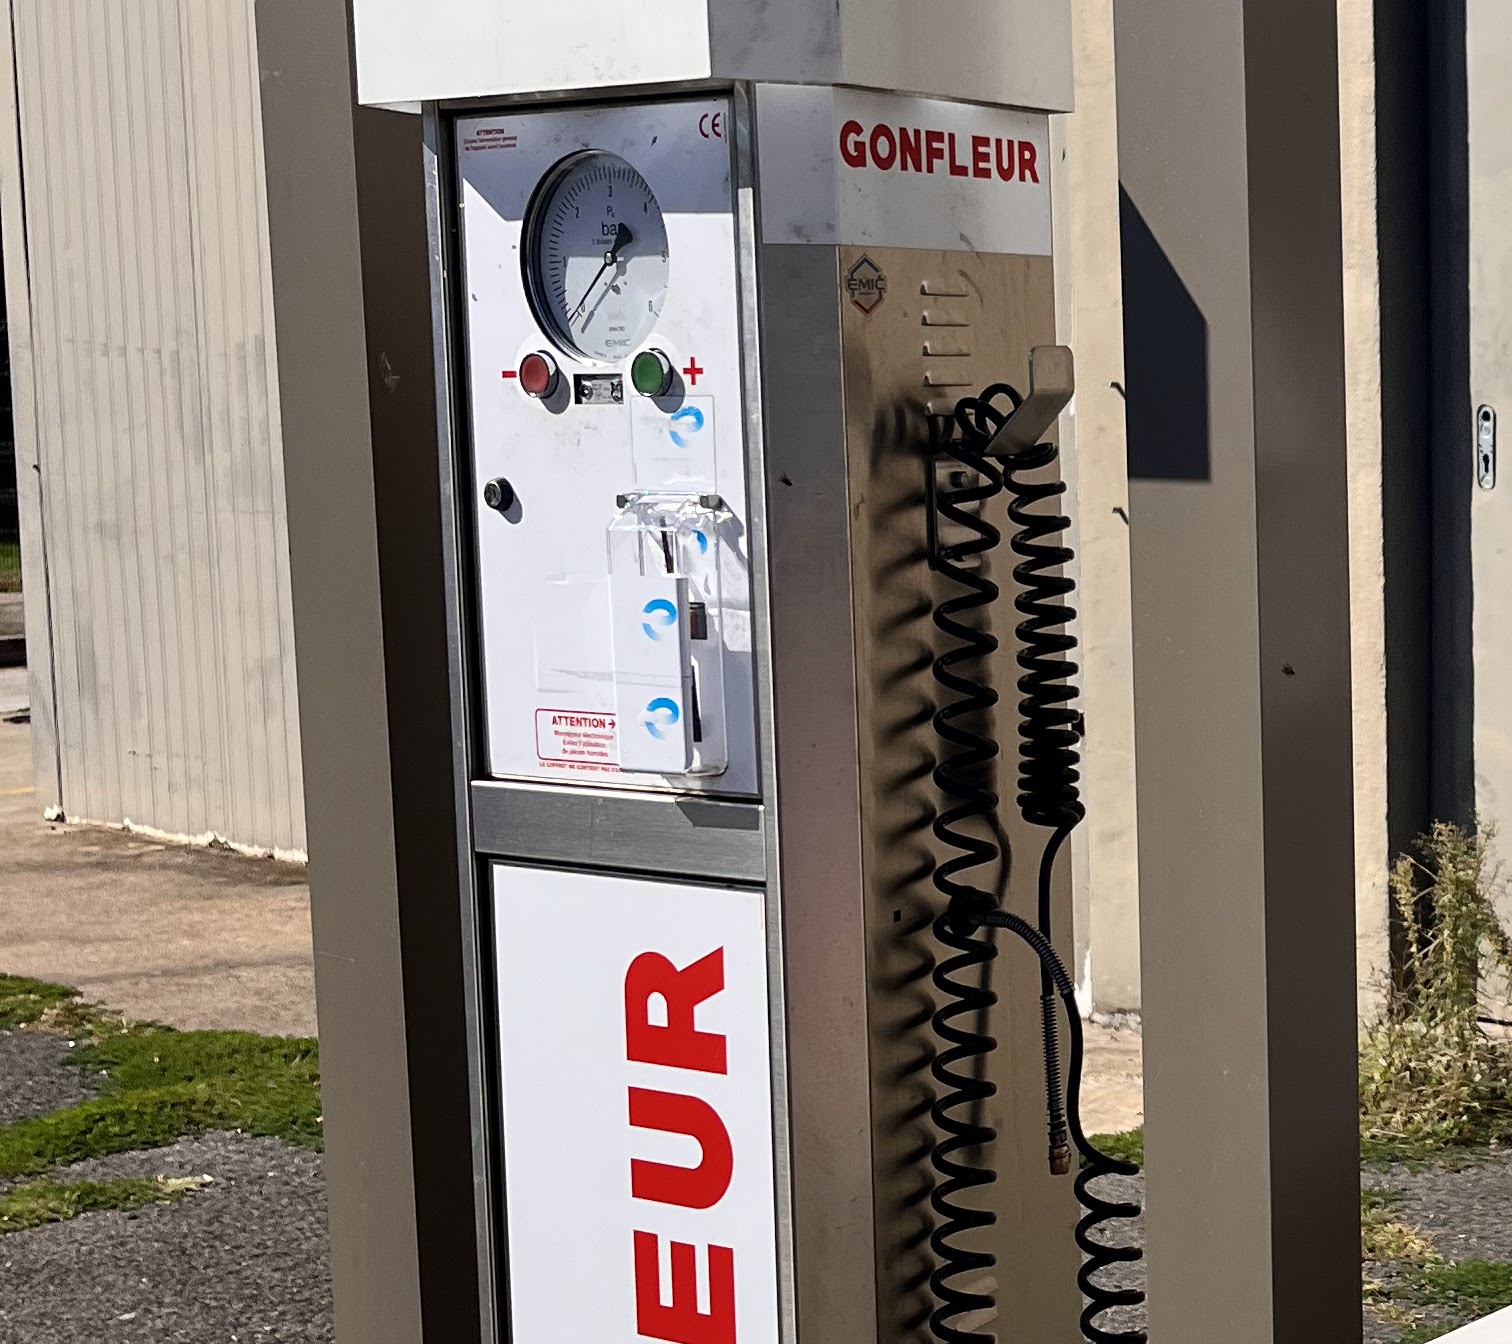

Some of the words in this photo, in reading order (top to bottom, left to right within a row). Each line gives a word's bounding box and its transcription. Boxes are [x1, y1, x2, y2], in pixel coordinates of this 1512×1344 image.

[839, 120, 1040, 184] GONFLEUR
[847, 277, 886, 291] EMIC
[552, 715, 606, 729] ATTENTION
